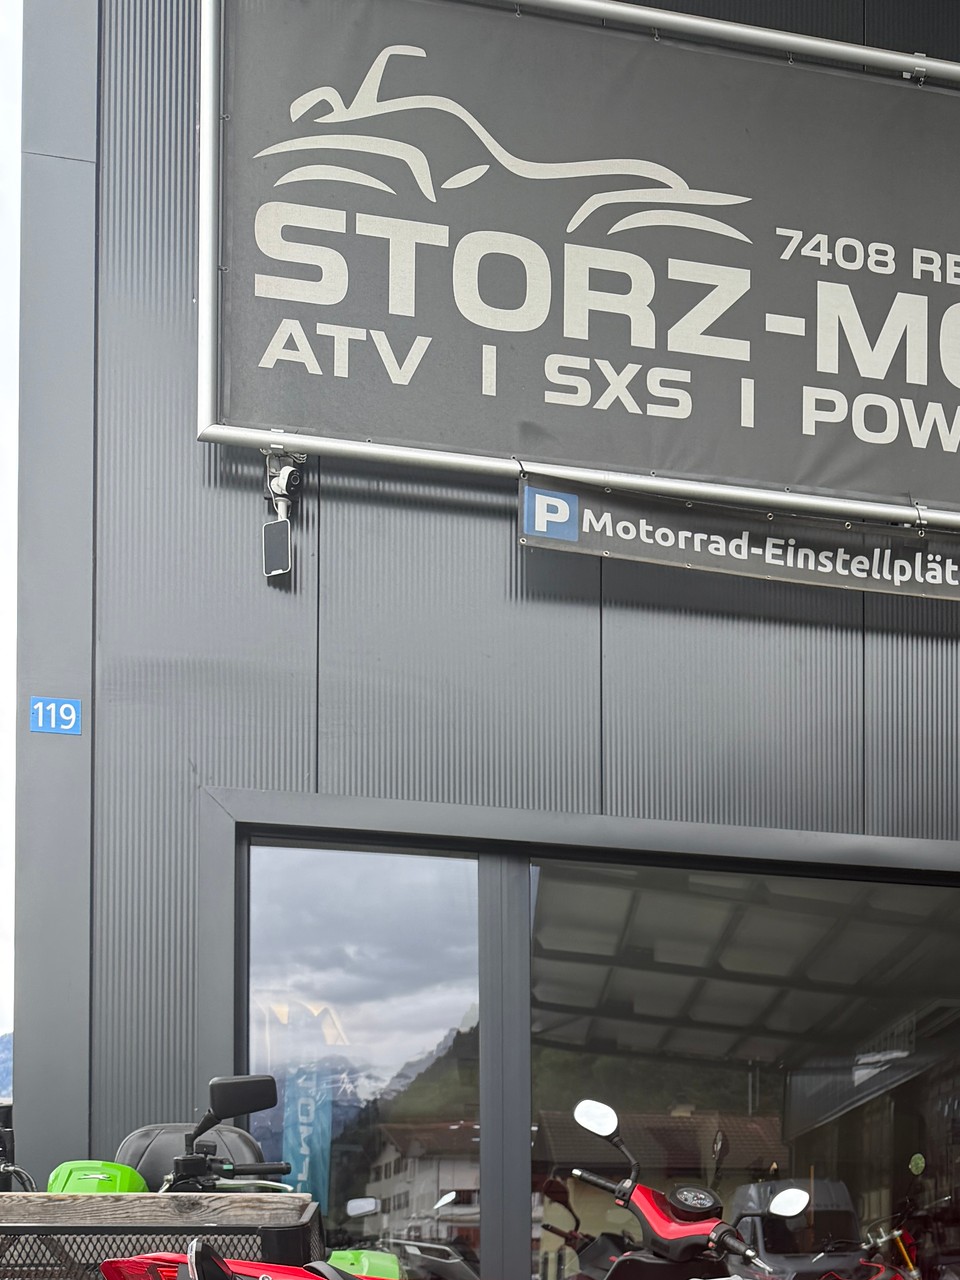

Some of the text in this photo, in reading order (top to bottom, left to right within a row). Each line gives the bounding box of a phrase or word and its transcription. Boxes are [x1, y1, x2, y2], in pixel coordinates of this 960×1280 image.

[775, 227, 895, 275] 7408
[258, 318, 432, 386] ATV
[544, 353, 692, 419] SXS
[33, 702, 76, 730] 119
